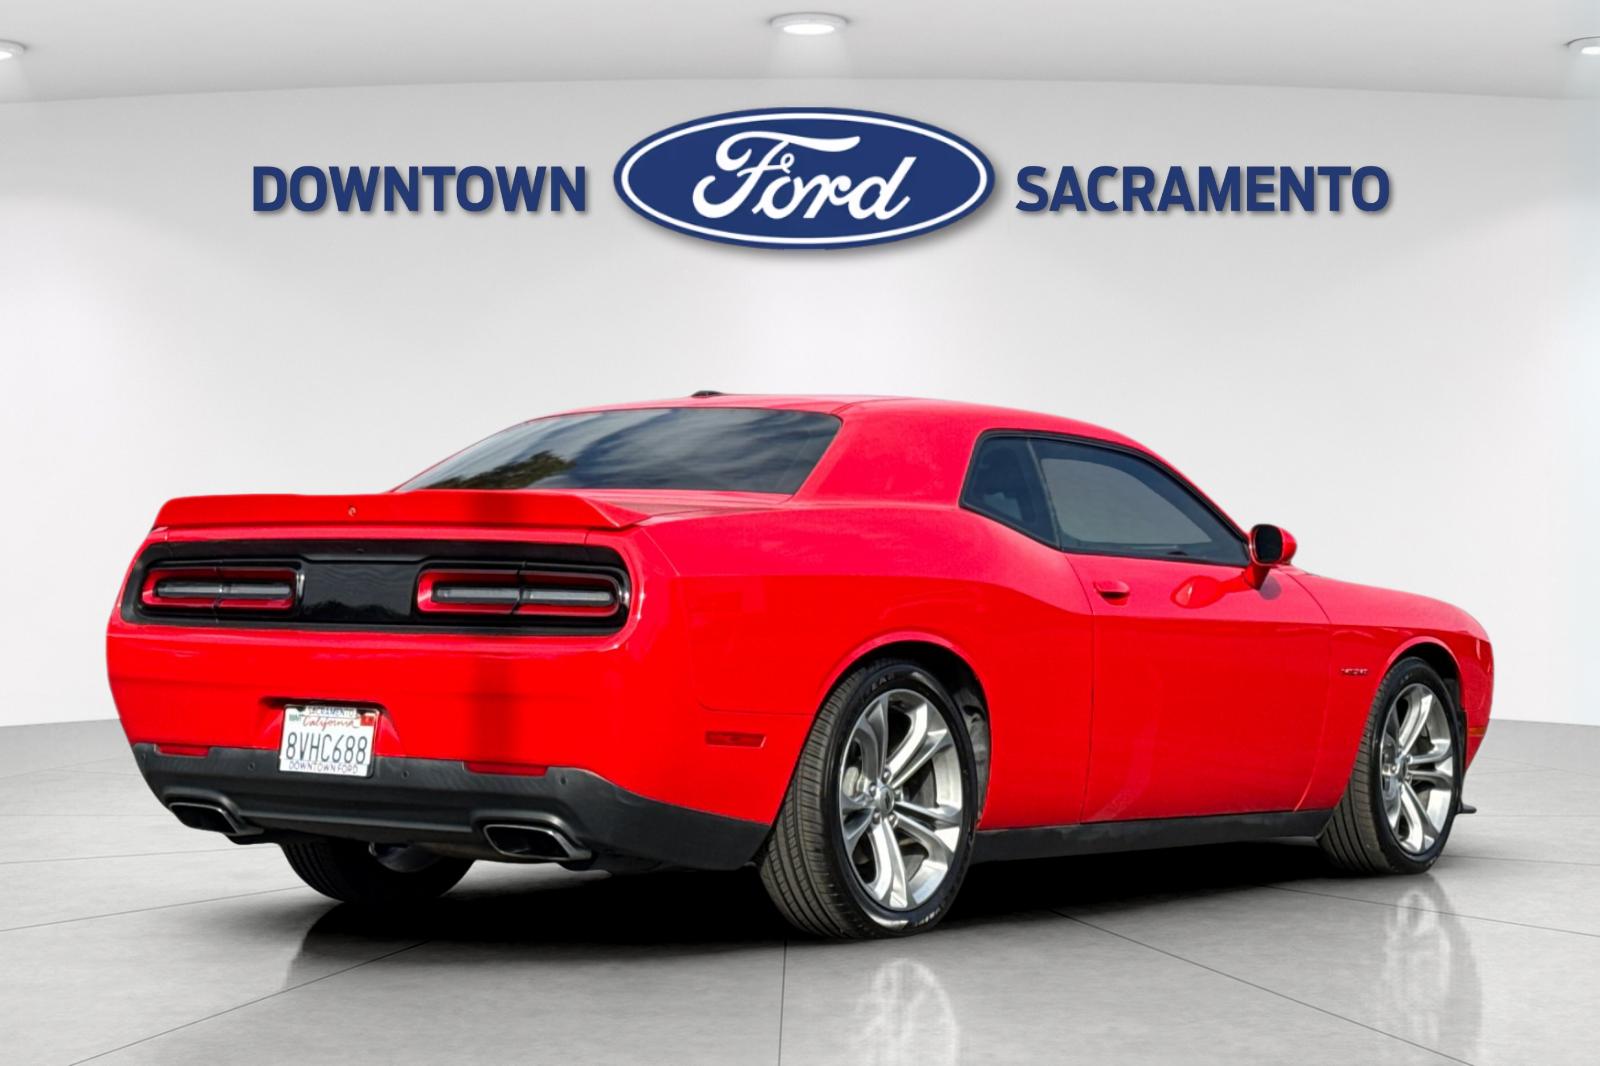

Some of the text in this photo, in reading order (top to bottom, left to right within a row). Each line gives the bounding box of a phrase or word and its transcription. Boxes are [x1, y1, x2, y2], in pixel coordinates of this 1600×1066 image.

[252, 131, 1389, 220] DOWNTOWN Ford SACRAMENTO
[303, 715, 354, 731] California
[286, 732, 368, 764] 8VHC688
